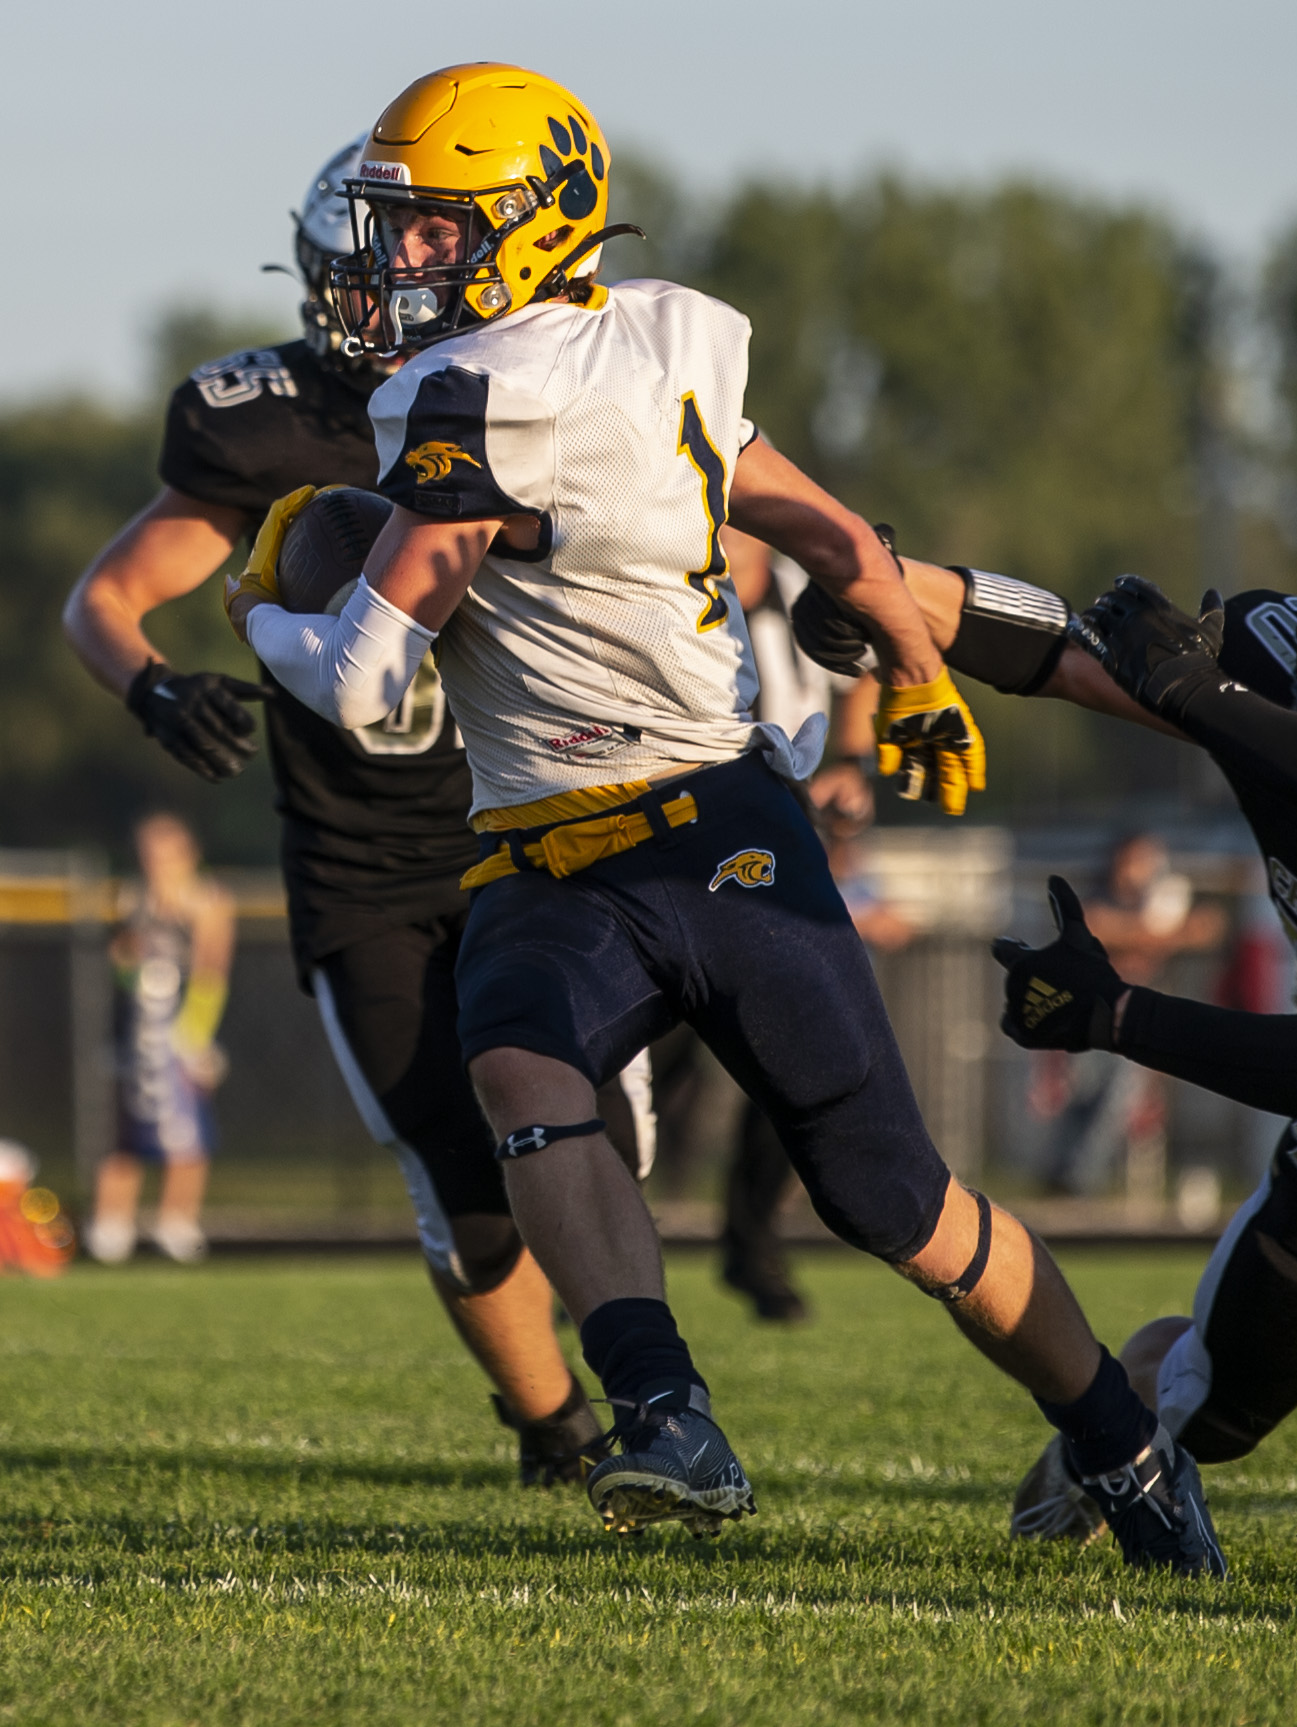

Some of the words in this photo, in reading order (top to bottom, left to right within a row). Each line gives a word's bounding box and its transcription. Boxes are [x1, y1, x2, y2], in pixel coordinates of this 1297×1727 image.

[360, 164, 401, 181] Riddell
[677, 389, 730, 634] 1
[1023, 990, 1074, 1030] adidas
